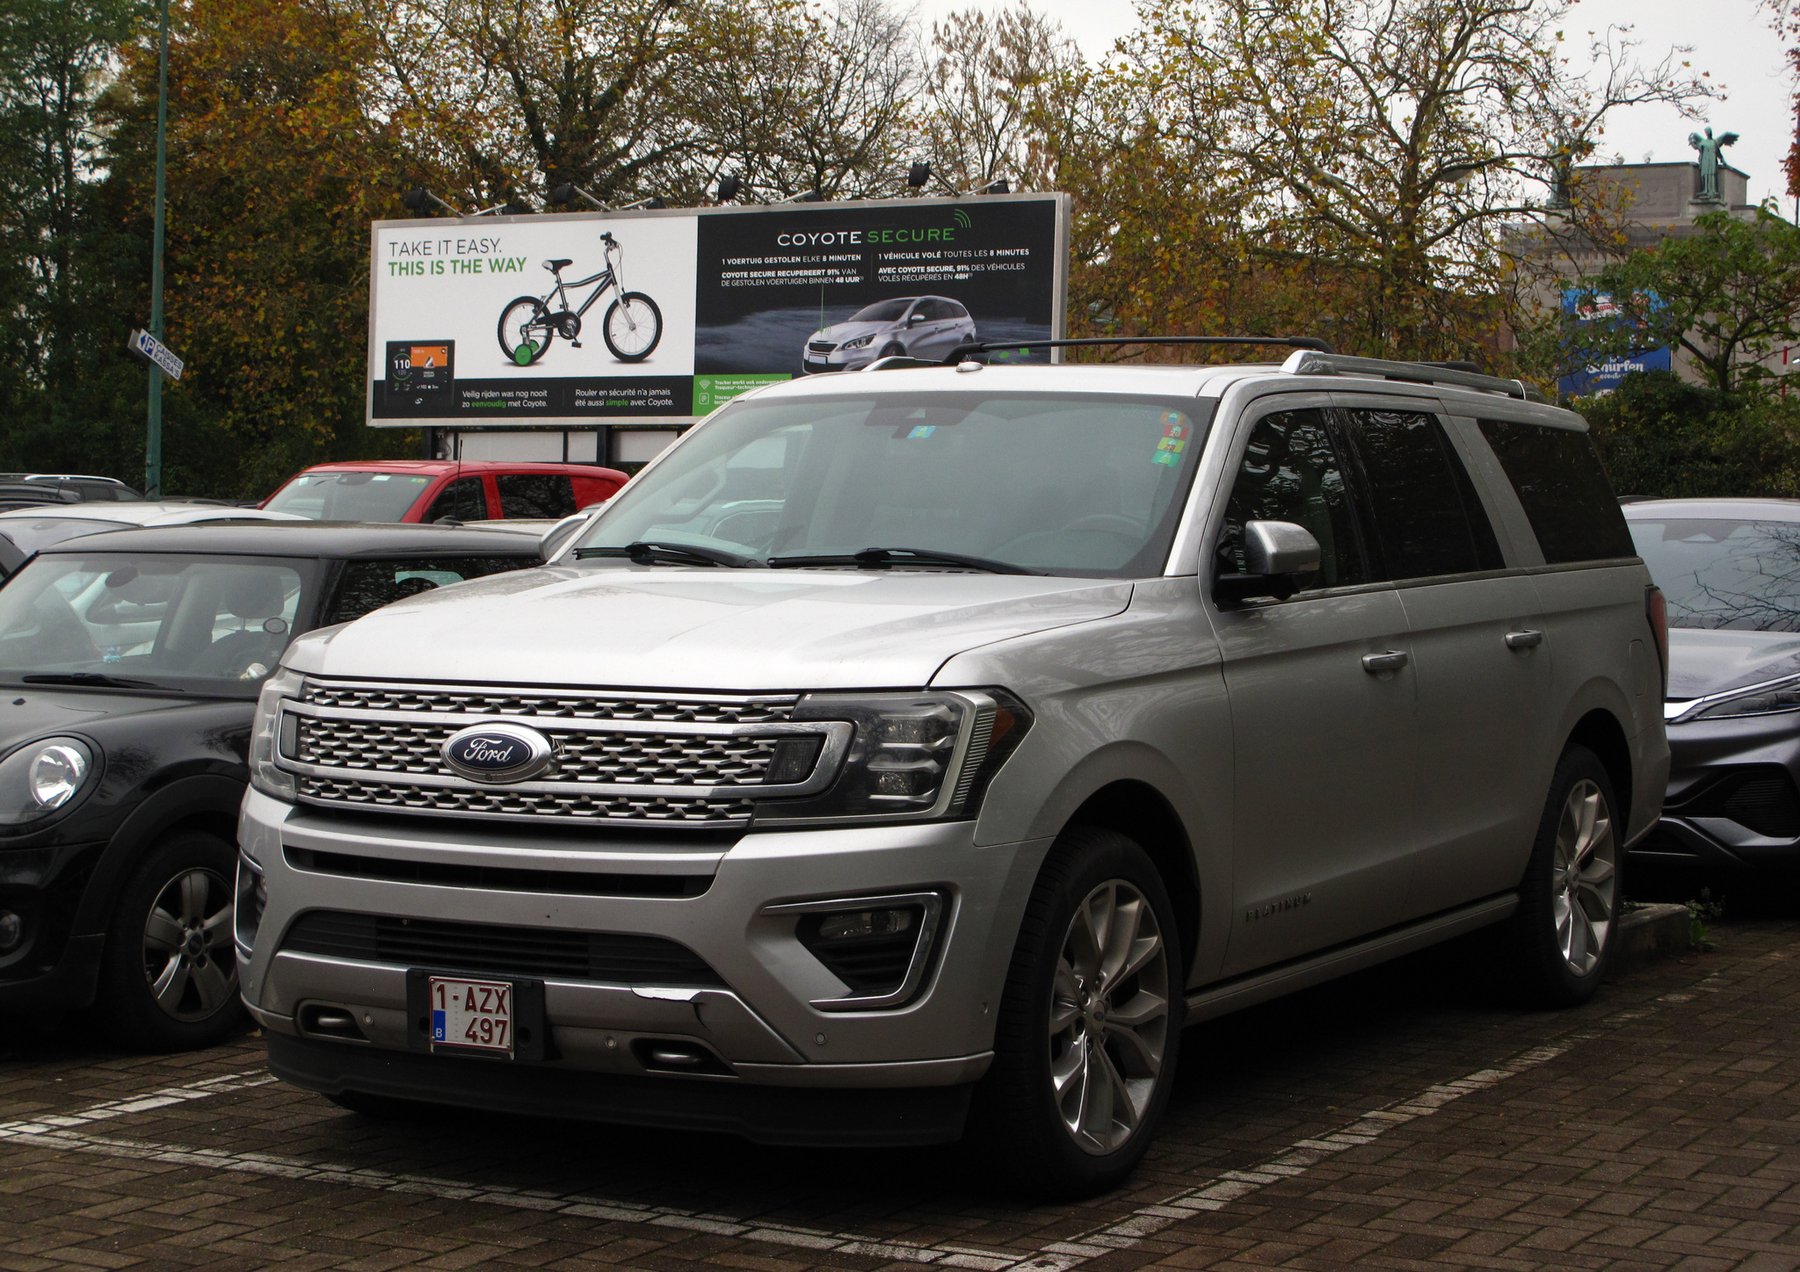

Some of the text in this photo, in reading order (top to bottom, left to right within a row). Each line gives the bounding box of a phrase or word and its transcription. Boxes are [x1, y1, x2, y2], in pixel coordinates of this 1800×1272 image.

[777, 228, 955, 246] COYOTE SECURE
[389, 238, 502, 256] TAKE IT EASY.
[388, 257, 527, 276] THIS IS THE WAY
[394, 360, 410, 369] 110
[462, 390, 480, 399] Veilig
[482, 390, 500, 398] rijden
[648, 388, 671, 396] jamais
[471, 400, 506, 408] eenvoudig
[522, 400, 548, 408] Coyote.
[605, 399, 629, 407] simple
[648, 398, 674, 407] Coyote.
[464, 738, 513, 762] Ford
[435, 1028, 442, 1038] B
[465, 1017, 508, 1045] 497
